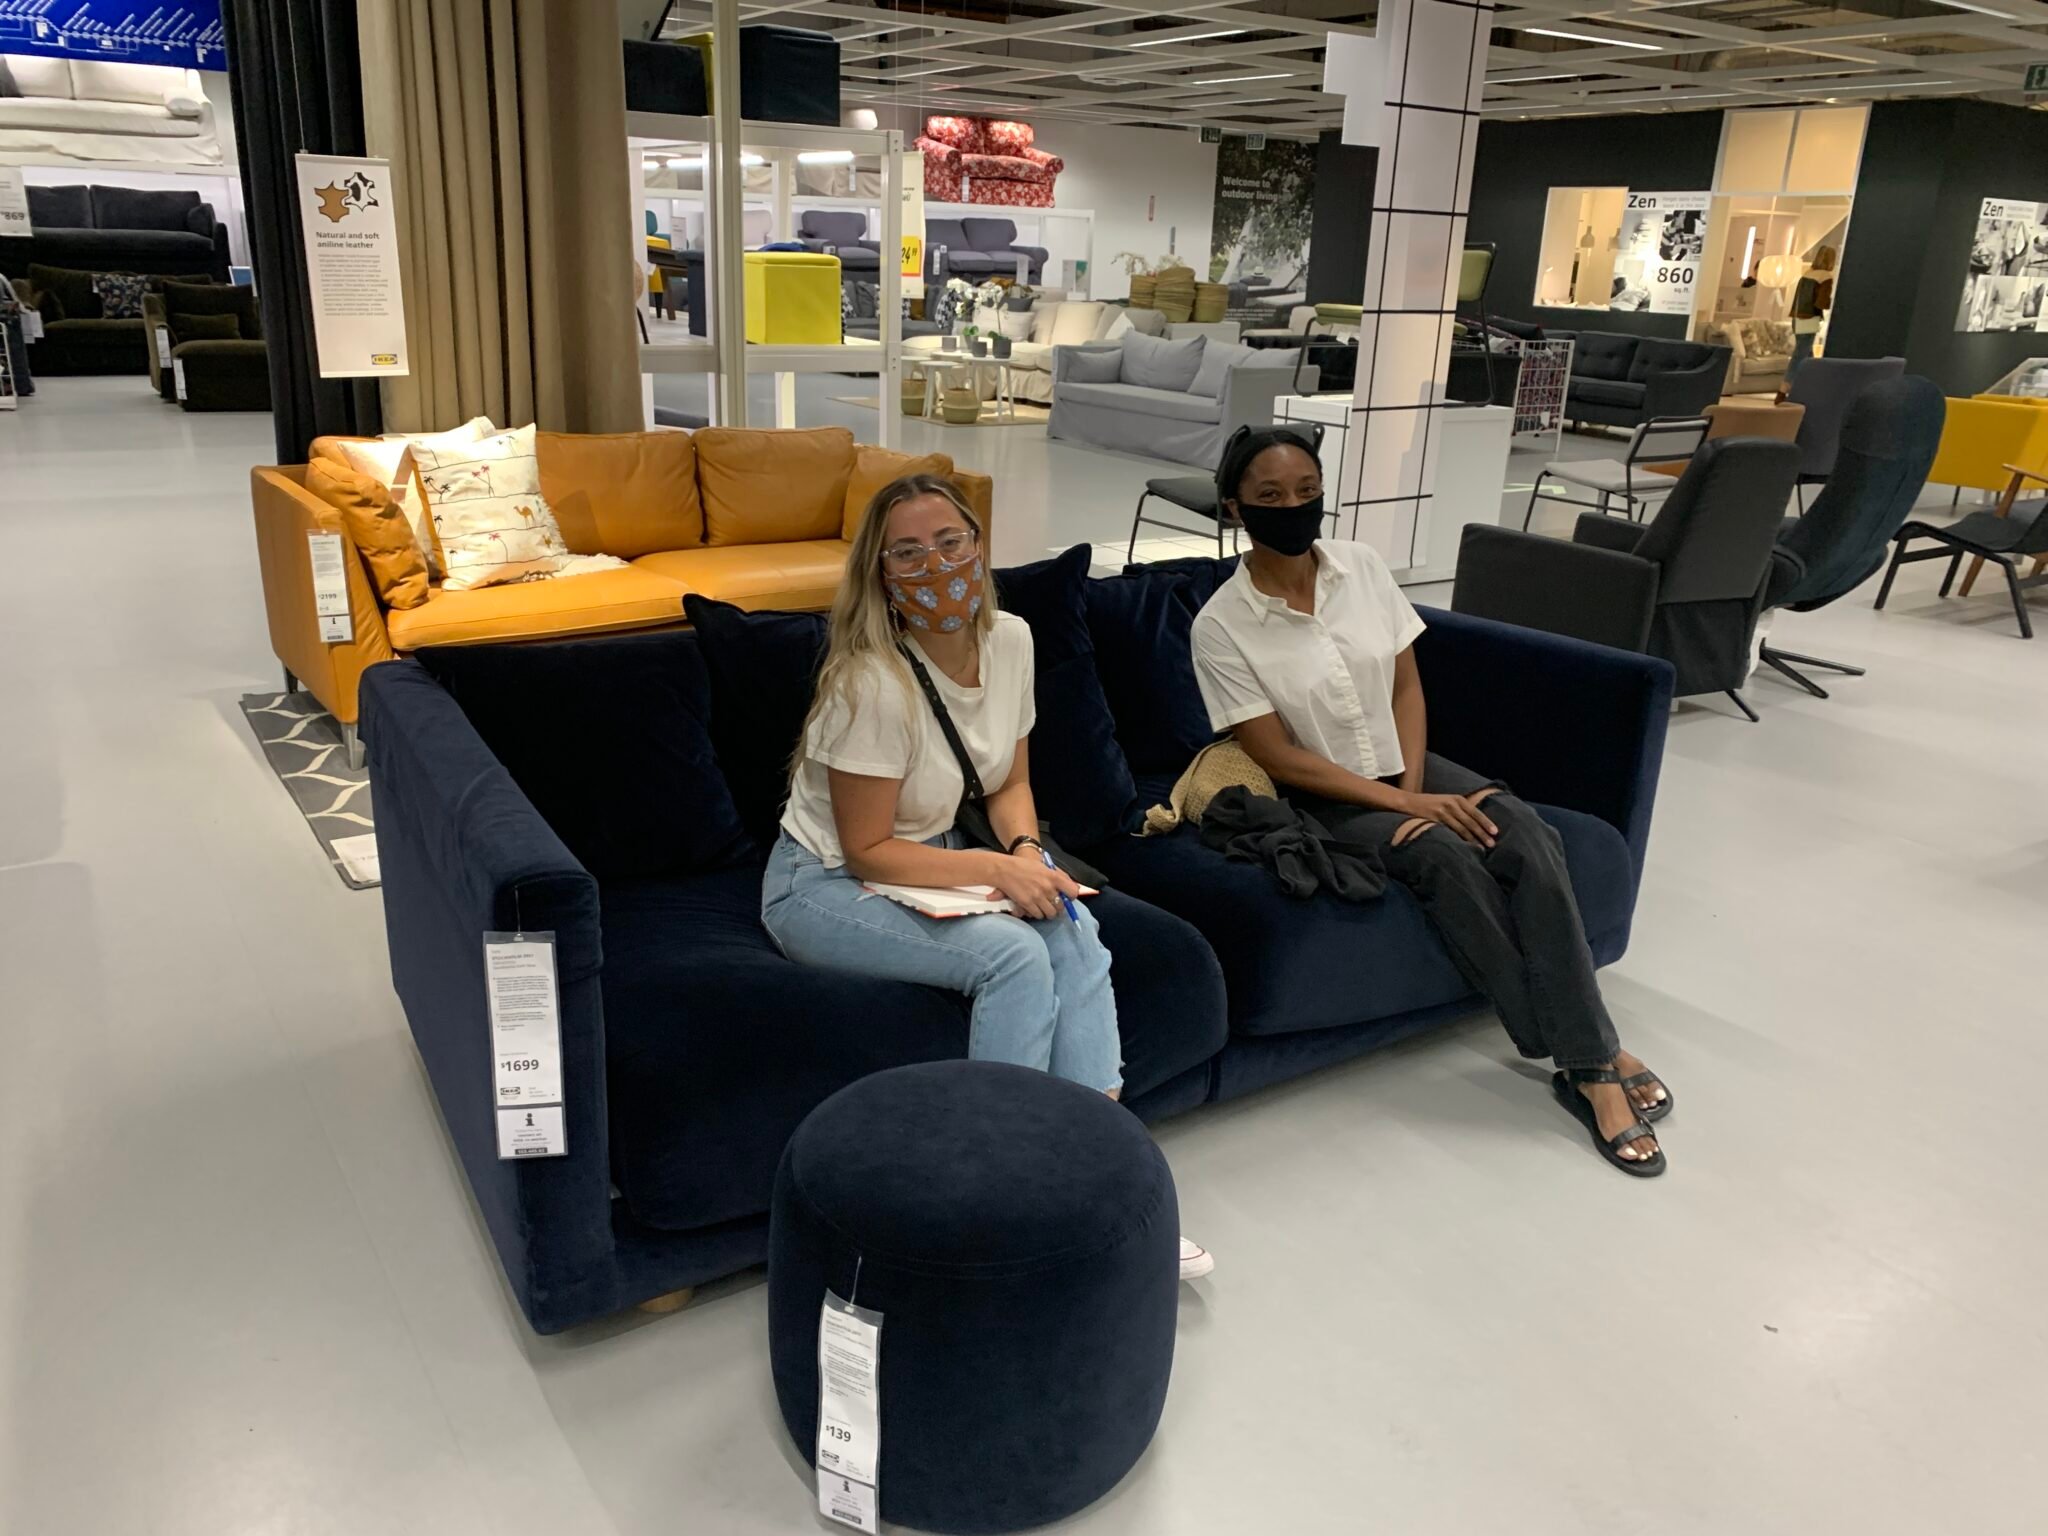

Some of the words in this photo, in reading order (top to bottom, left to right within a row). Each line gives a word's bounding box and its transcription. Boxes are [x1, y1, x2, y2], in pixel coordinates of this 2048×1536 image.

[1222, 176, 1260, 188] Welcome
[1262, 179, 1271, 188] to
[1222, 189, 1255, 200] outdoor
[1256, 190, 1278, 202] living
[1628, 195, 1657, 208] Zen
[1983, 201, 2004, 217] Zen
[316, 231, 347, 239] Natural
[364, 232, 380, 240] soft
[317, 240, 344, 248] aniline
[345, 241, 374, 249] leather
[1657, 267, 1694, 284] 860
[501, 1059, 540, 1072] $1699
[825, 1424, 852, 1443] $139
